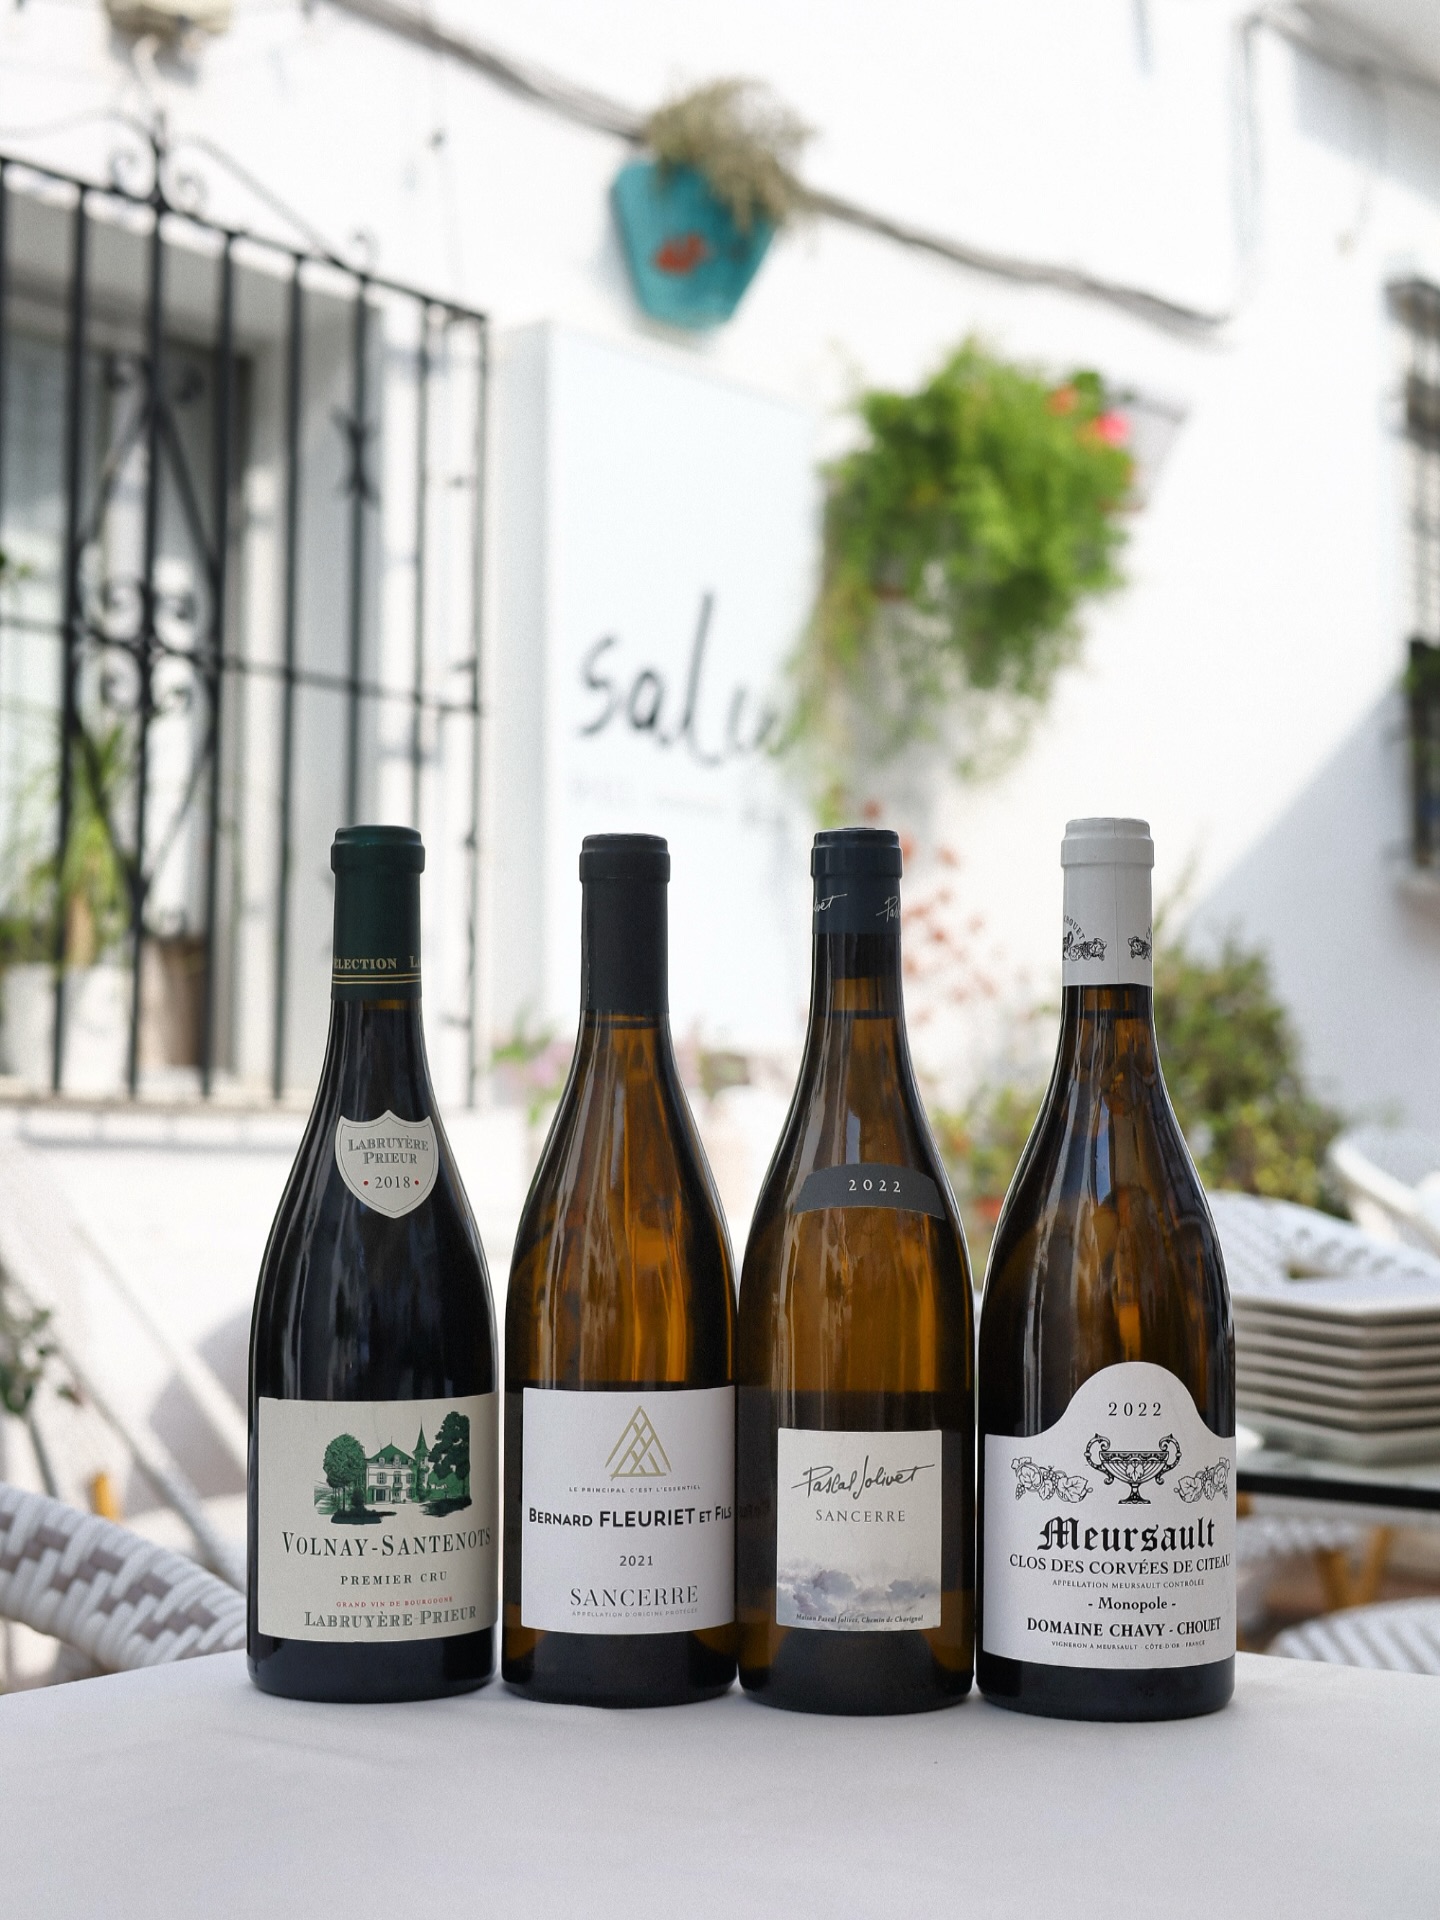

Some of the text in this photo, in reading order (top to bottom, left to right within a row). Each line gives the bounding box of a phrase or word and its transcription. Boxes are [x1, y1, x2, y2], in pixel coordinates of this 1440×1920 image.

[374, 1176, 411, 1189] 2018
[848, 1179, 901, 1193] 2022
[1108, 1402, 1162, 1417] 2022
[791, 1455, 935, 1500] Pascal Jolivet
[656, 1484, 701, 1493] L'ESSENTIEL
[600, 1508, 696, 1528] FLEURIET
[700, 1510, 712, 1523] ET
[815, 1509, 906, 1523] SANCERRE
[1037, 1516, 1215, 1551] Meursault
[619, 1555, 654, 1567] 2021
[1009, 1553, 1047, 1570] CLOS
[1051, 1558, 1084, 1574] DES
[1089, 1558, 1169, 1575] CORVÉES
[1173, 1559, 1193, 1574] DE
[341, 1571, 448, 1586] PREMIER CRU
[1052, 1579, 1109, 1588] APPELLATION
[404, 1596, 454, 1607] BOURGOGNE
[570, 1585, 698, 1607] SANCERRE
[1097, 1596, 1168, 1613] Monopole
[796, 1613, 816, 1621] Maison
[817, 1615, 837, 1623] Pascal
[1027, 1617, 1103, 1636] DOMAINE
[1109, 1623, 1166, 1637] CHAVY
[1177, 1616, 1221, 1635] CHOUET
[1051, 1640, 1087, 1648] VIGNERON
